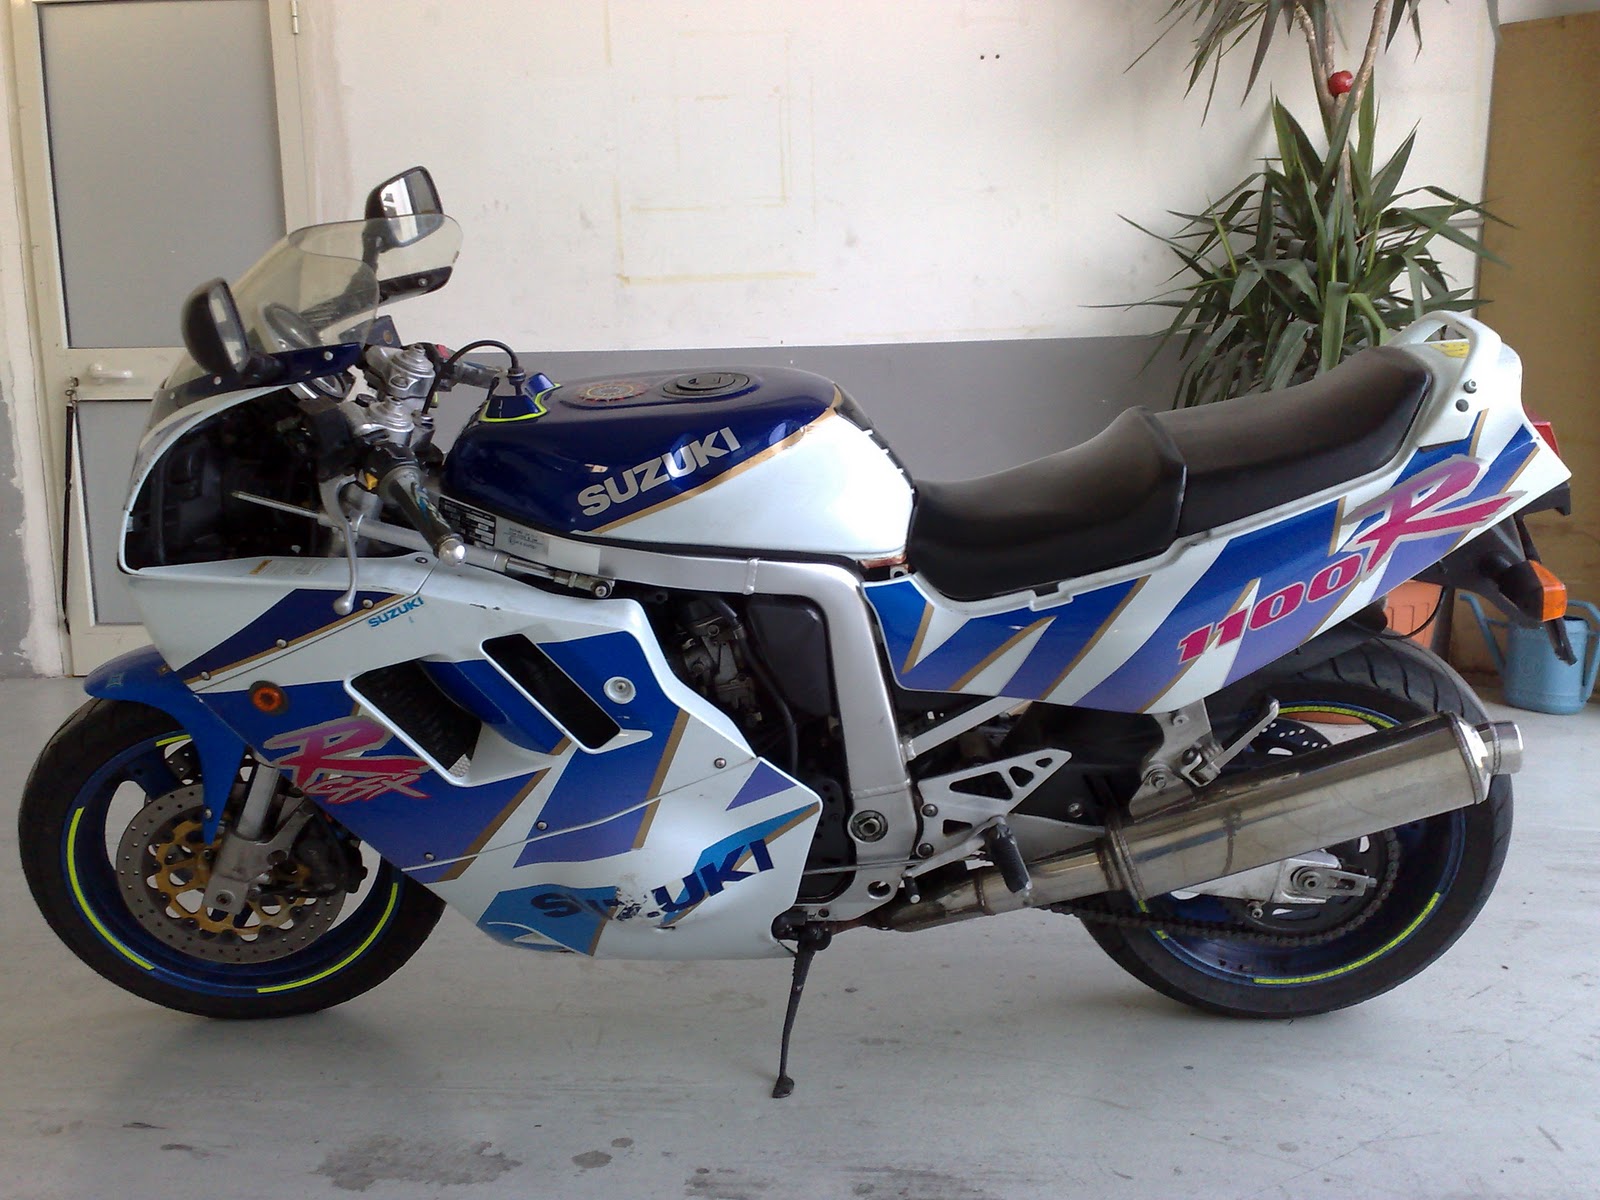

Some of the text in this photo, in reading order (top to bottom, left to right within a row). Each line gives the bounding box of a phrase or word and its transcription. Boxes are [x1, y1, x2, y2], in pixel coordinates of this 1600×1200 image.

[577, 426, 742, 516] SUZUKI
[368, 596, 424, 628] SUZUKI
[1177, 553, 1363, 662] 1100
[303, 772, 431, 804] GSX
